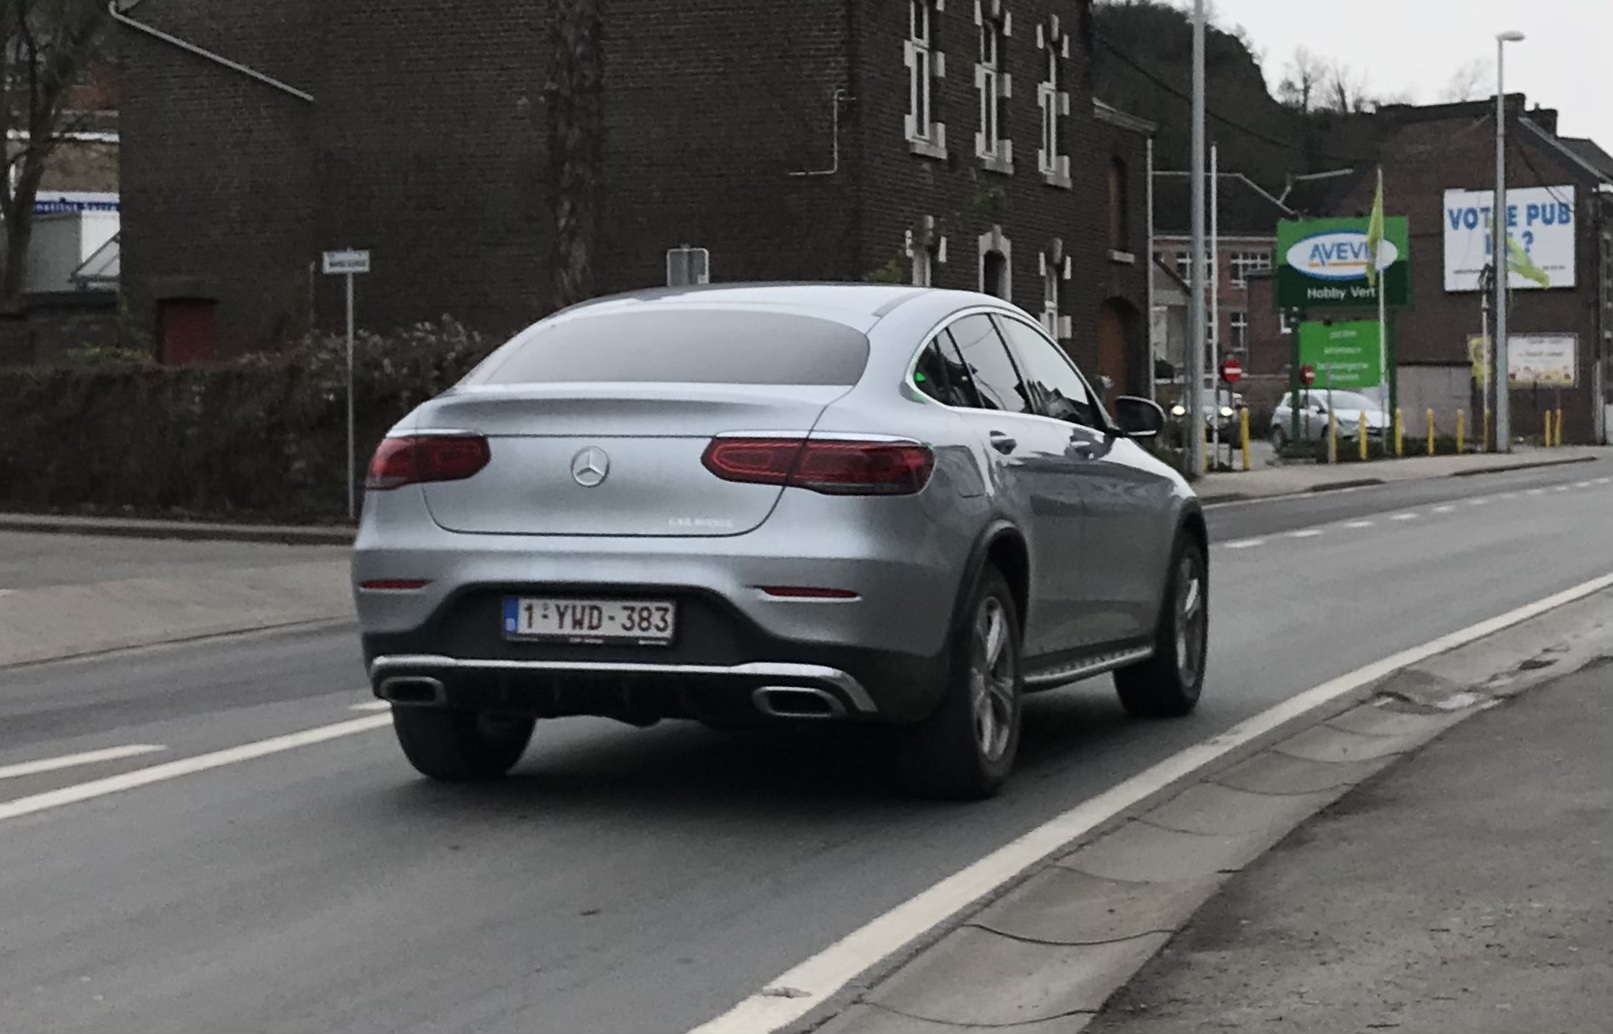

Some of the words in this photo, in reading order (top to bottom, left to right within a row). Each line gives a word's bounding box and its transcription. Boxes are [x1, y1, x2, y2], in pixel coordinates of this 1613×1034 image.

[1447, 206, 1518, 231] VOTE
[1526, 203, 1571, 226] PUB
[1307, 287, 1346, 300] Hobby
[1350, 286, 1376, 298] Vert
[524, 603, 669, 633] 1-YWD-383
